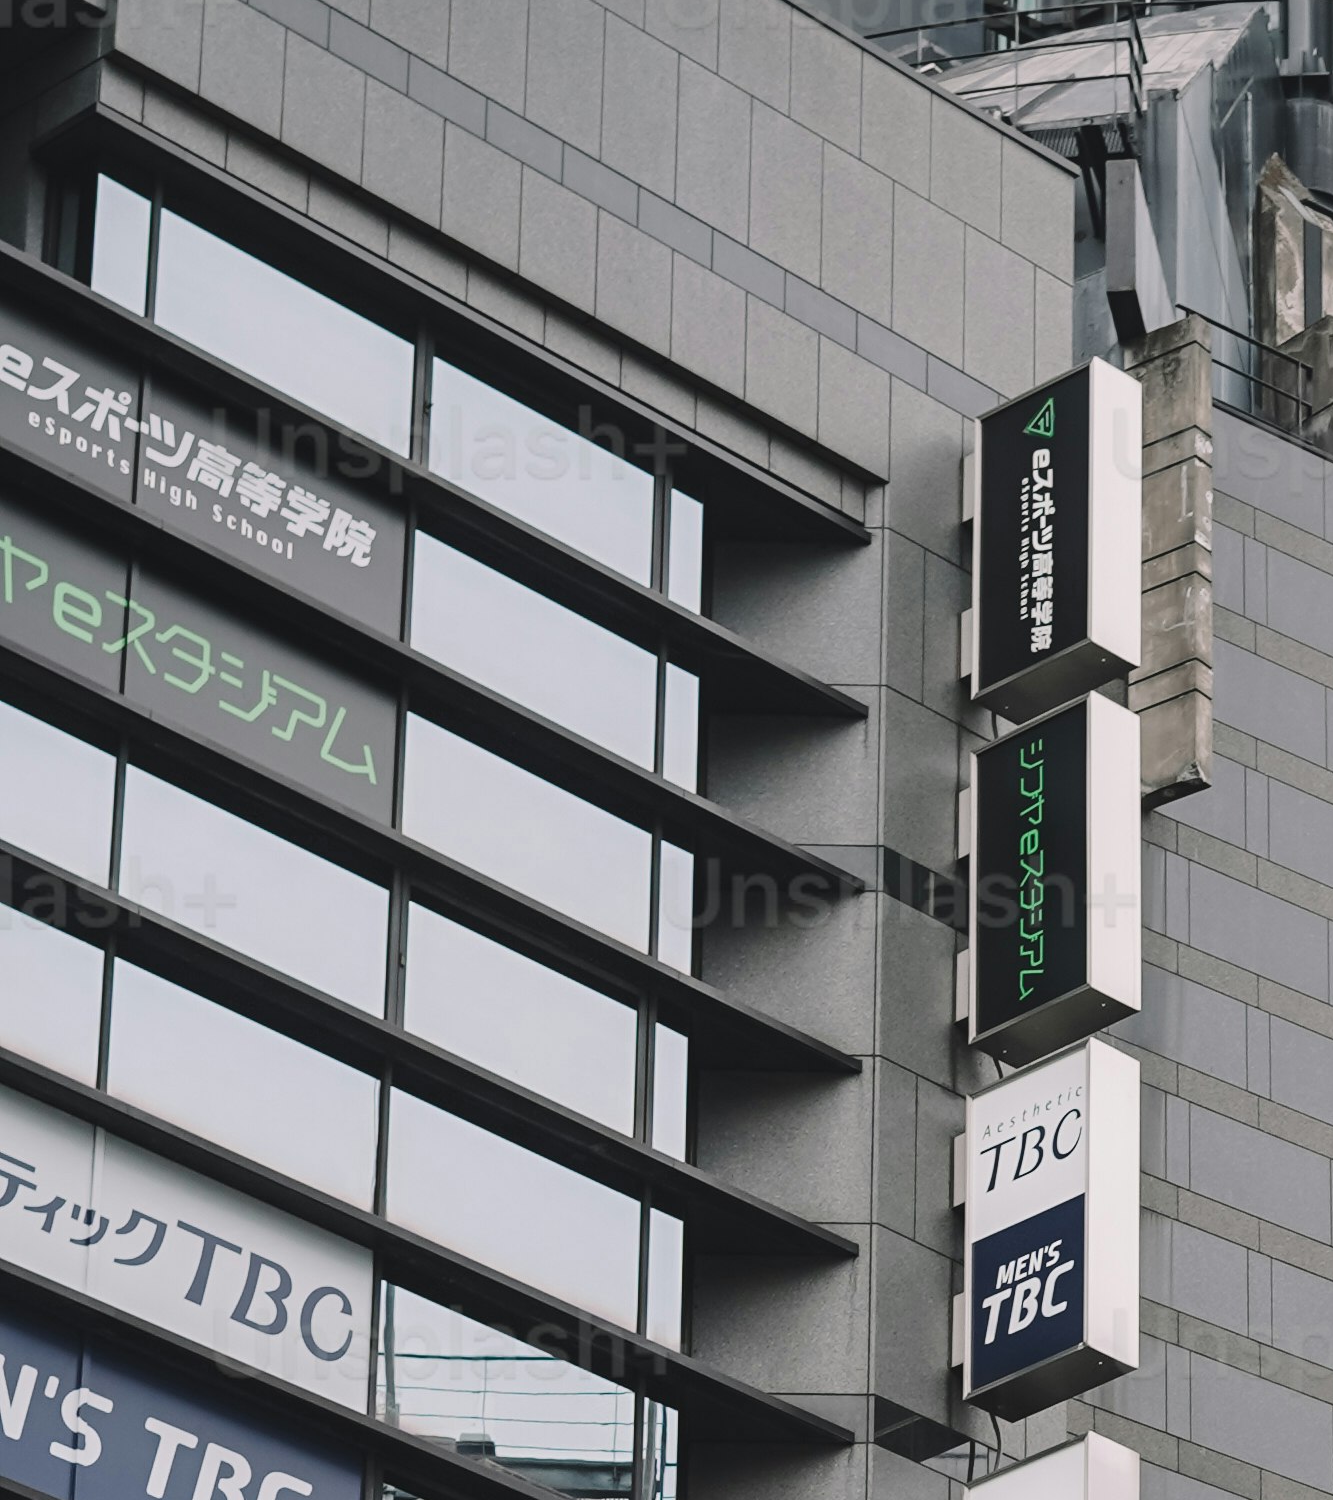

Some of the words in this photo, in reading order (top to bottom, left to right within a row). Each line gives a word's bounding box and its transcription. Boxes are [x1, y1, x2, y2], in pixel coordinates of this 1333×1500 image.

[0, 343, 378, 568] eスポーツ高等学院
[28, 409, 131, 476] eSports
[143, 467, 198, 511] High
[211, 503, 294, 560] School
[1031, 447, 1057, 654] eスポーツ高等学院
[980, 1107, 1083, 1193] TBC
[982, 1083, 1084, 1141] Aesthetic
[982, 1260, 1075, 1345] TBC
[995, 1239, 1063, 1290] MEN'S
